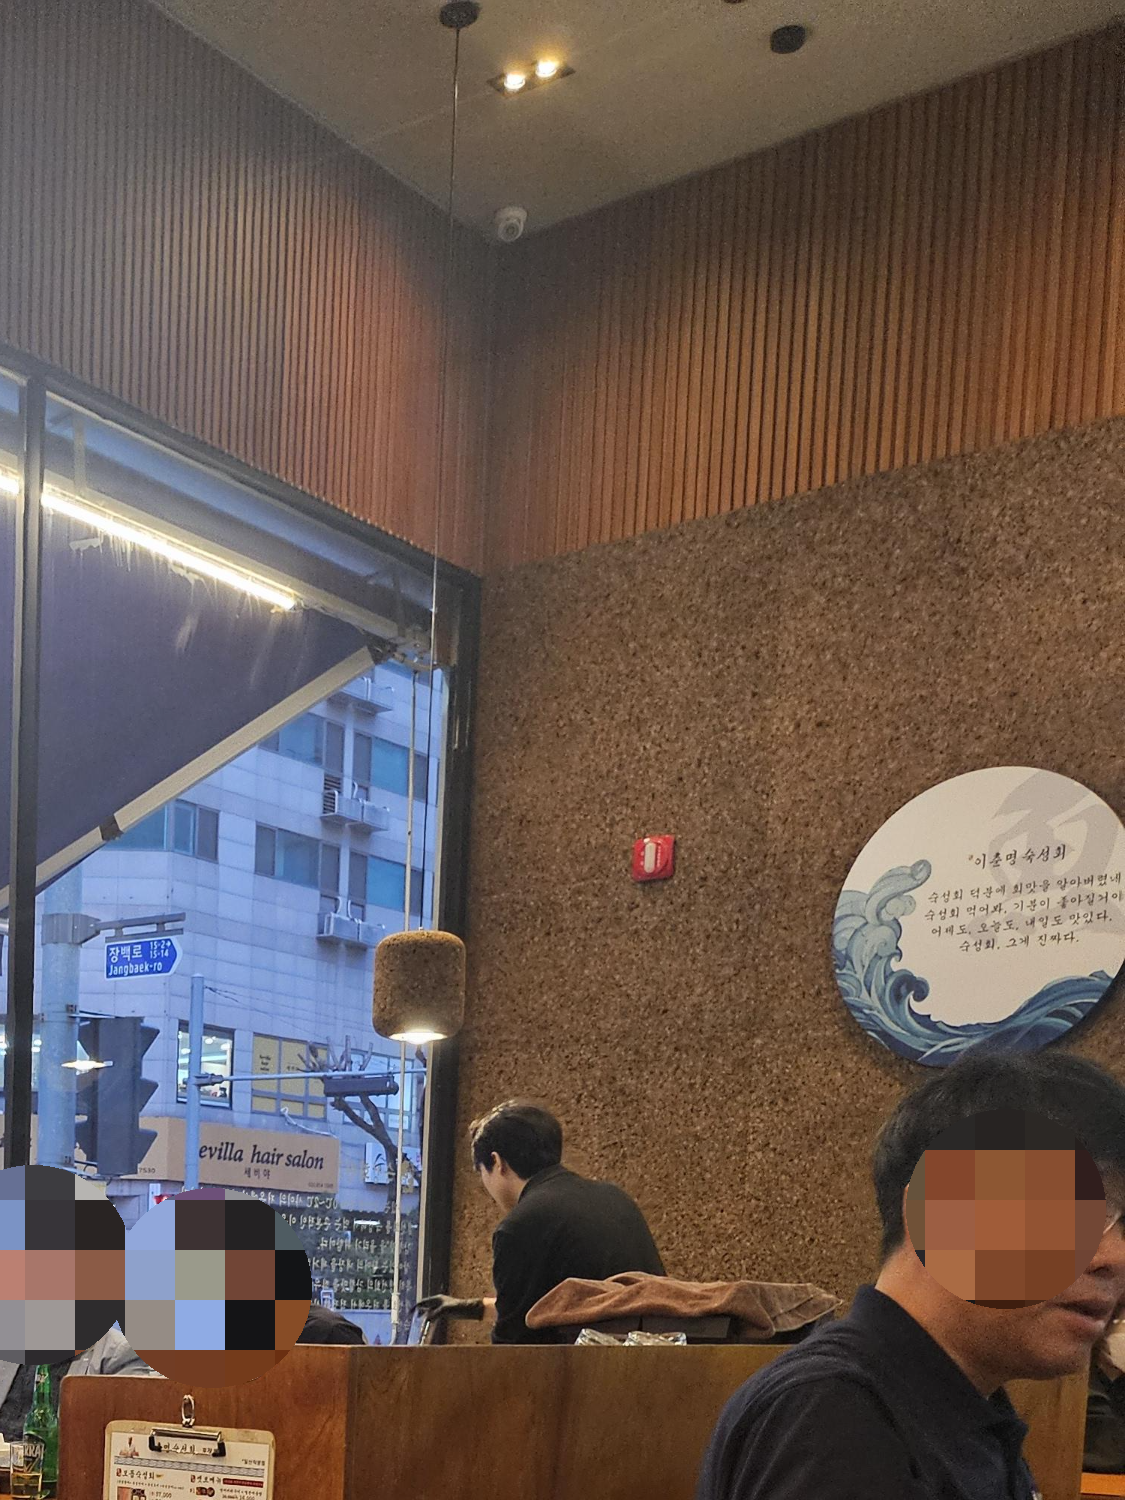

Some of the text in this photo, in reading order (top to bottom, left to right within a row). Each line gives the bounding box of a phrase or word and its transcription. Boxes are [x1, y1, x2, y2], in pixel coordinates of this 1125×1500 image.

[928, 888, 963, 903] 숙성회
[970, 883, 1006, 898] 덕분에
[1012, 879, 1050, 895] 회맛을
[925, 906, 960, 922] 숙성회
[1013, 897, 1050, 912] 기분이
[1025, 914, 1063, 929] 내일도
[1069, 909, 1112, 926] 맛있다.
[1006, 935, 1029, 948] 그게
[1038, 931, 1080, 947] 진짜다.
[109, 940, 165, 963] 장백로 15-2
[149, 949, 169, 959] 15-14
[108, 961, 163, 976] Jangbaek-ro
[199, 1141, 324, 1170] evilla hair salon
[244, 1166, 271, 1180] 세비야
